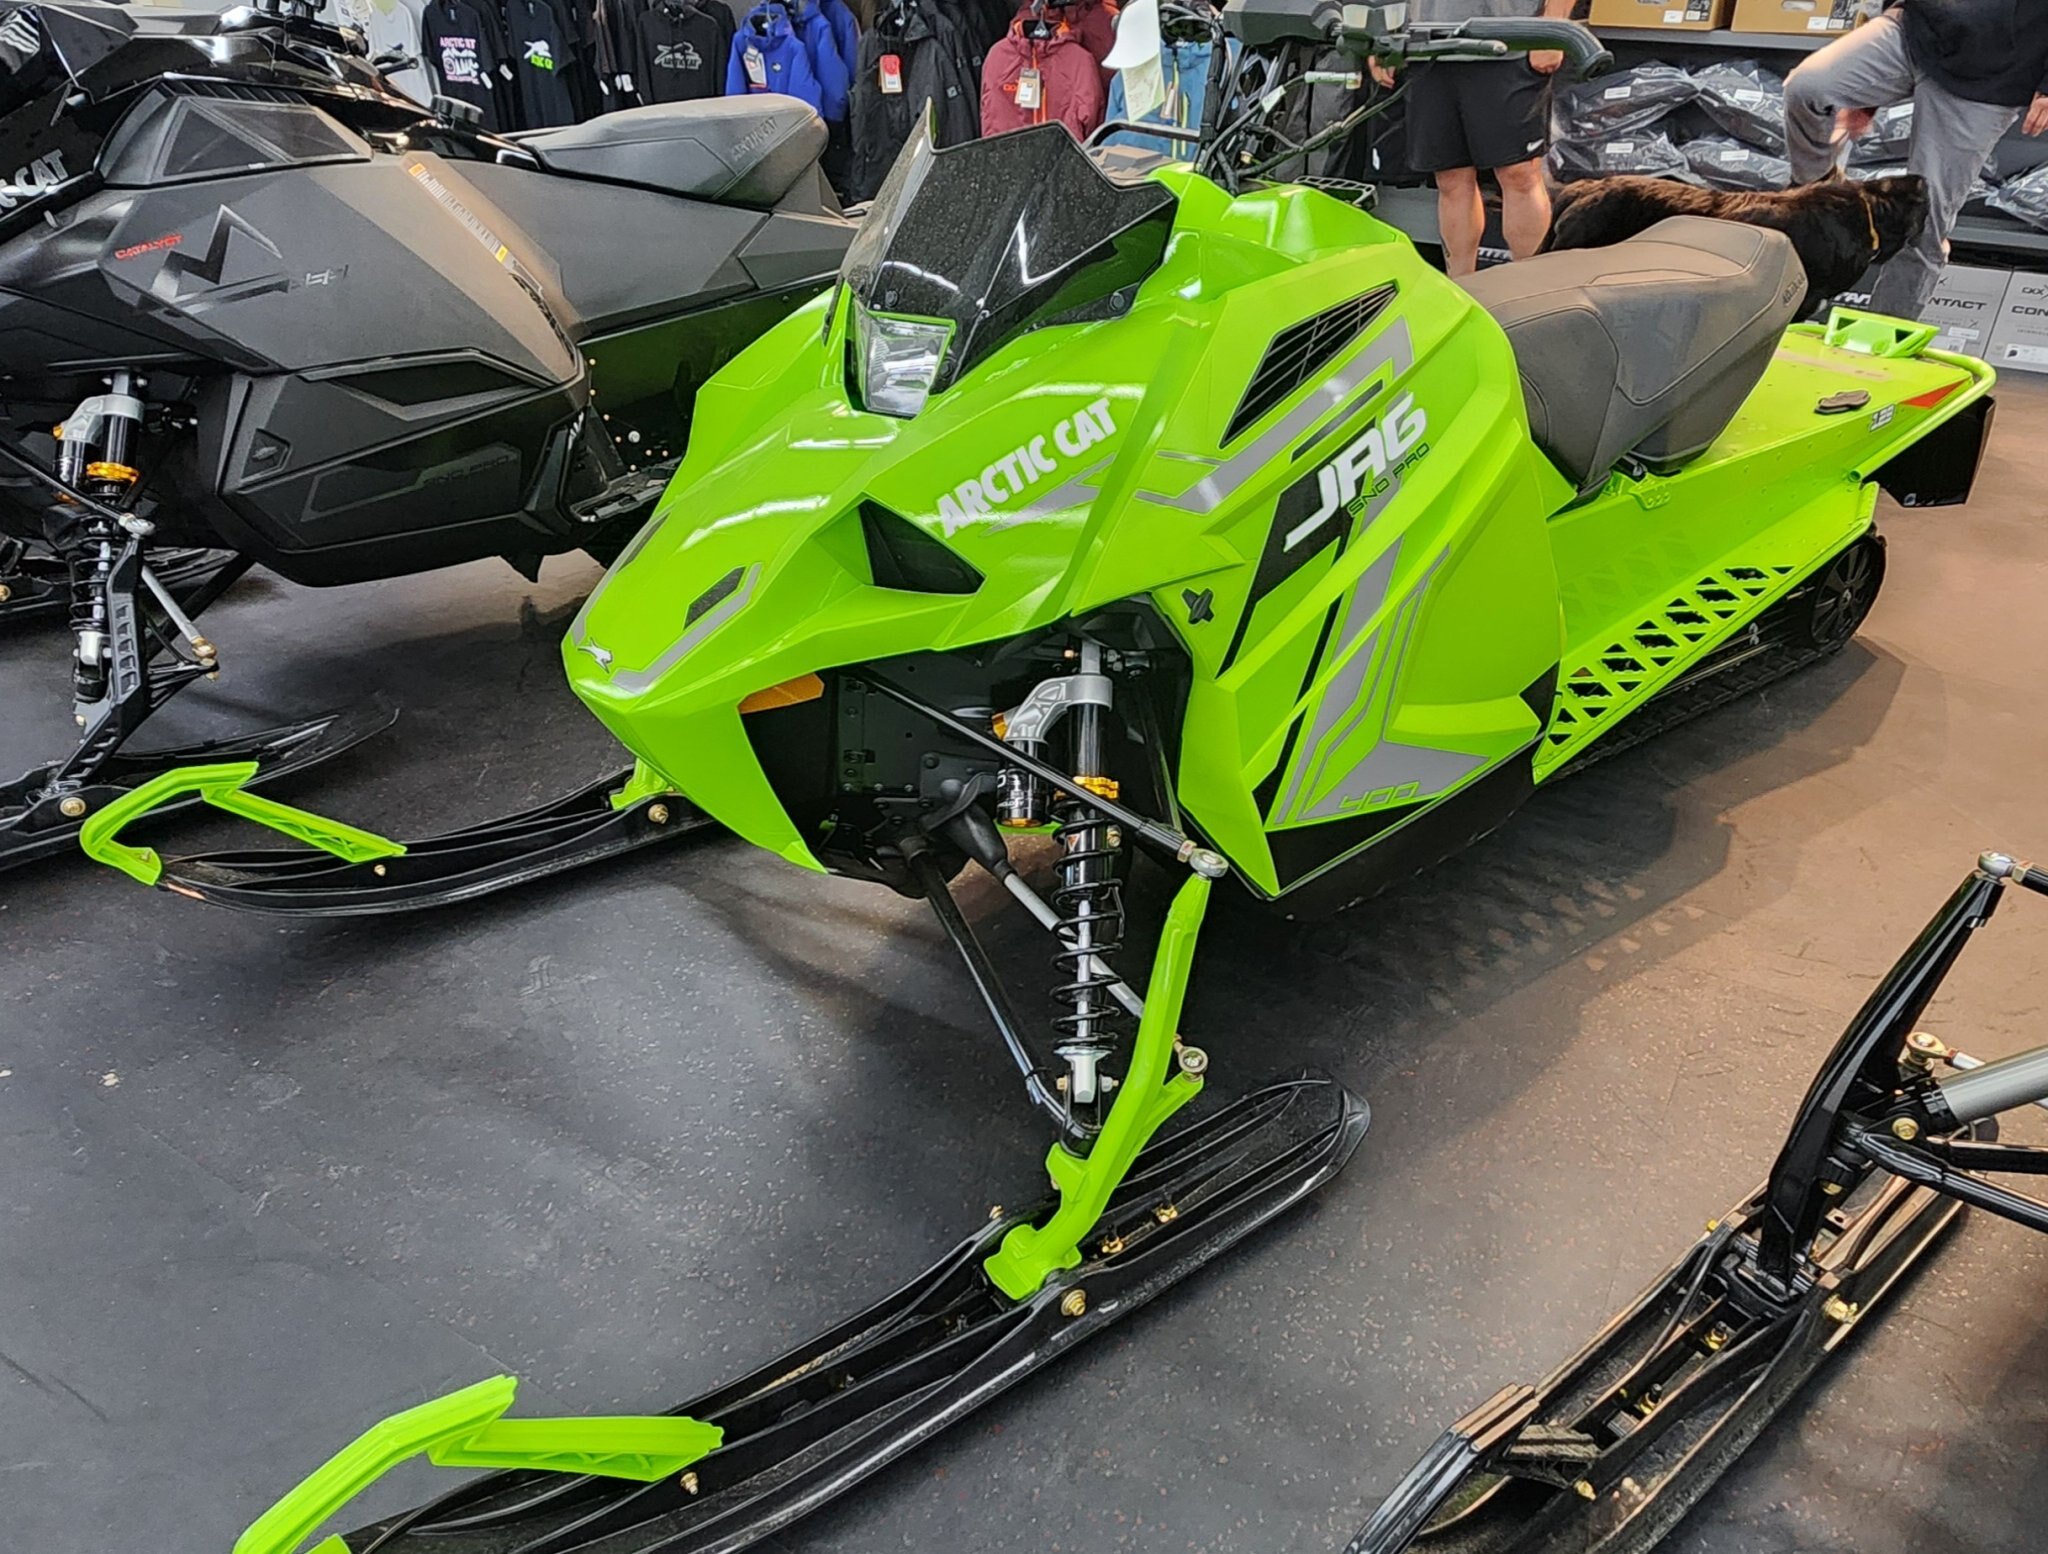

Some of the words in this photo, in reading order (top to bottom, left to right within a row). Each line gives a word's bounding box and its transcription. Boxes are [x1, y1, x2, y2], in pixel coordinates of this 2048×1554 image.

[15, 149, 69, 196] CAT
[1928, 296, 1988, 312] NTACT
[936, 434, 1058, 539] ARCTIC
[1053, 397, 1117, 458] CAT
[1283, 391, 1427, 553] JAG
[1347, 477, 1390, 517] SNO
[1392, 442, 1431, 479] PRO
[1338, 781, 1420, 811] 400
